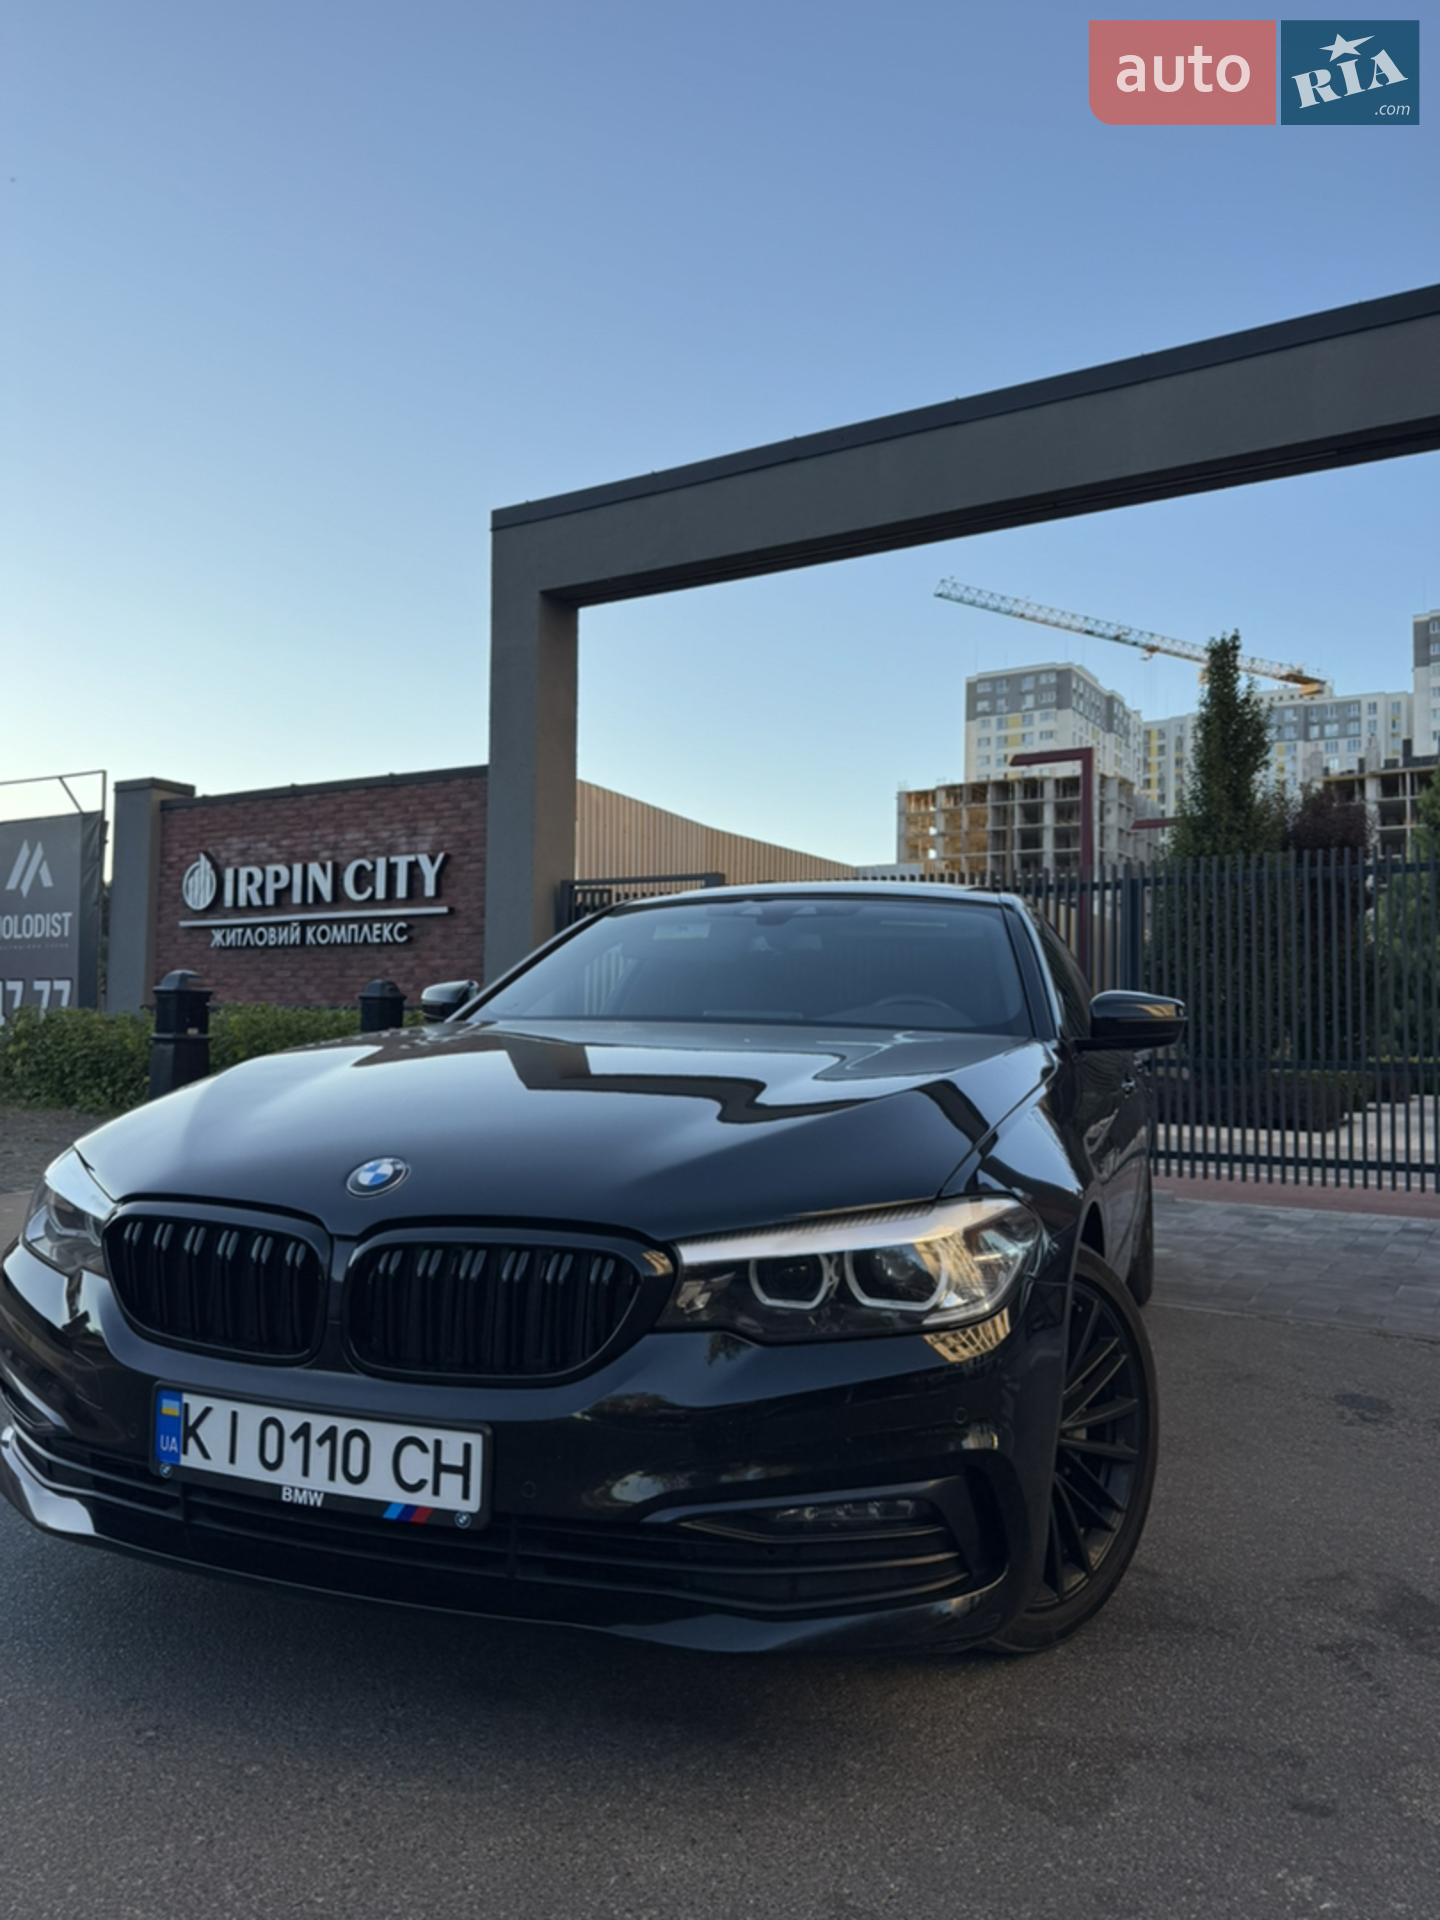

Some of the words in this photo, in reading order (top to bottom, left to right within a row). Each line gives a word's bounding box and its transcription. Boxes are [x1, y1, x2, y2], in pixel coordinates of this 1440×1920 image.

[223, 860, 333, 908] IRPIN
[343, 852, 446, 902] CITY
[0, 911, 73, 939] OLODIST
[210, 922, 301, 948] ЖИТЛОВИЙ
[305, 921, 409, 946] КОМПЛЕКС
[160, 1434, 178, 1454] UA
[258, 1415, 371, 1485] 0110
[392, 1435, 472, 1501] CH
[281, 1485, 324, 1507] BMW
